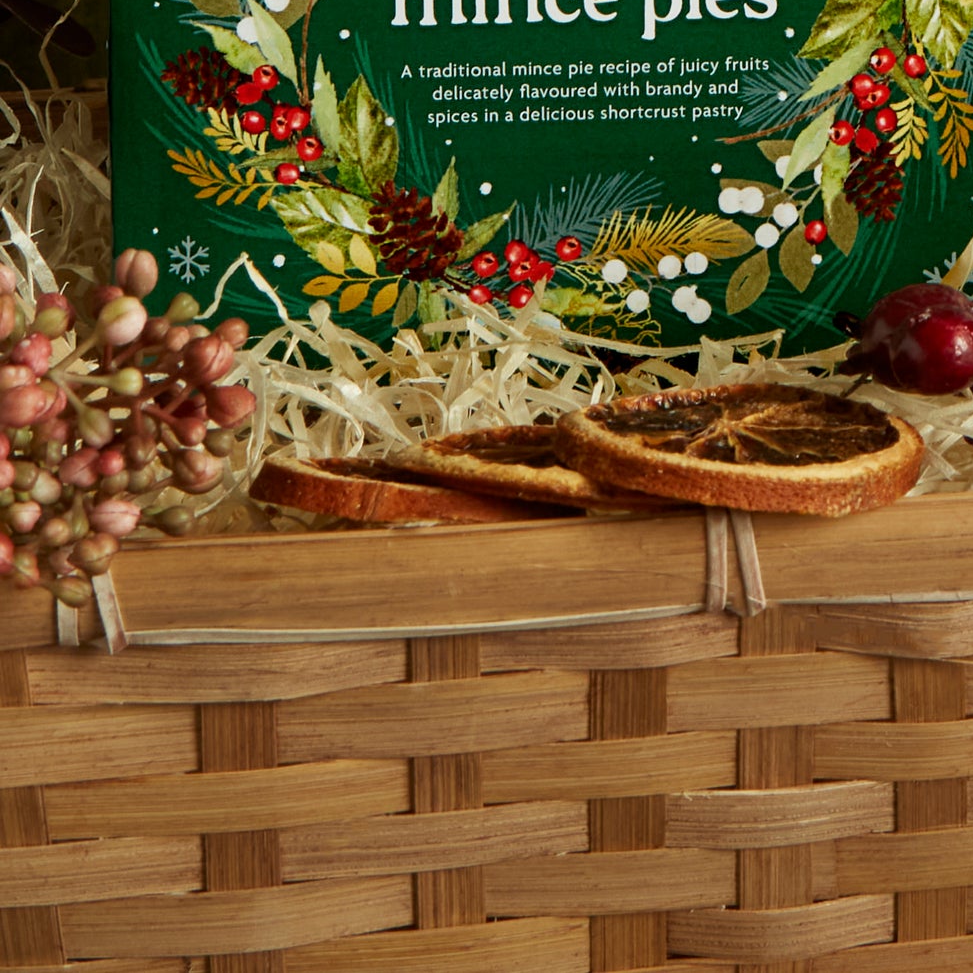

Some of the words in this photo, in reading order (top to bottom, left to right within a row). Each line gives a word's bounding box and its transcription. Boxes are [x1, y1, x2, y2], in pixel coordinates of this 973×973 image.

[401, 65, 412, 78] A
[418, 62, 507, 78] traditional
[512, 61, 562, 76] mince
[568, 61, 593, 78] pie
[600, 59, 651, 77] recipe
[657, 58, 675, 74] of
[680, 57, 719, 76] juicy
[724, 56, 769, 72] fruits
[432, 85, 513, 103] delicately
[520, 84, 598, 99] flavoured
[603, 83, 640, 97] with
[646, 81, 703, 99] brandy
[708, 80, 738, 95] and
[427, 107, 478, 127] spices
[484, 108, 499, 123] in
[504, 110, 514, 122] a
[520, 106, 594, 122] delicious
[600, 105, 686, 120] shortcrust
[692, 105, 744, 122] pastry
